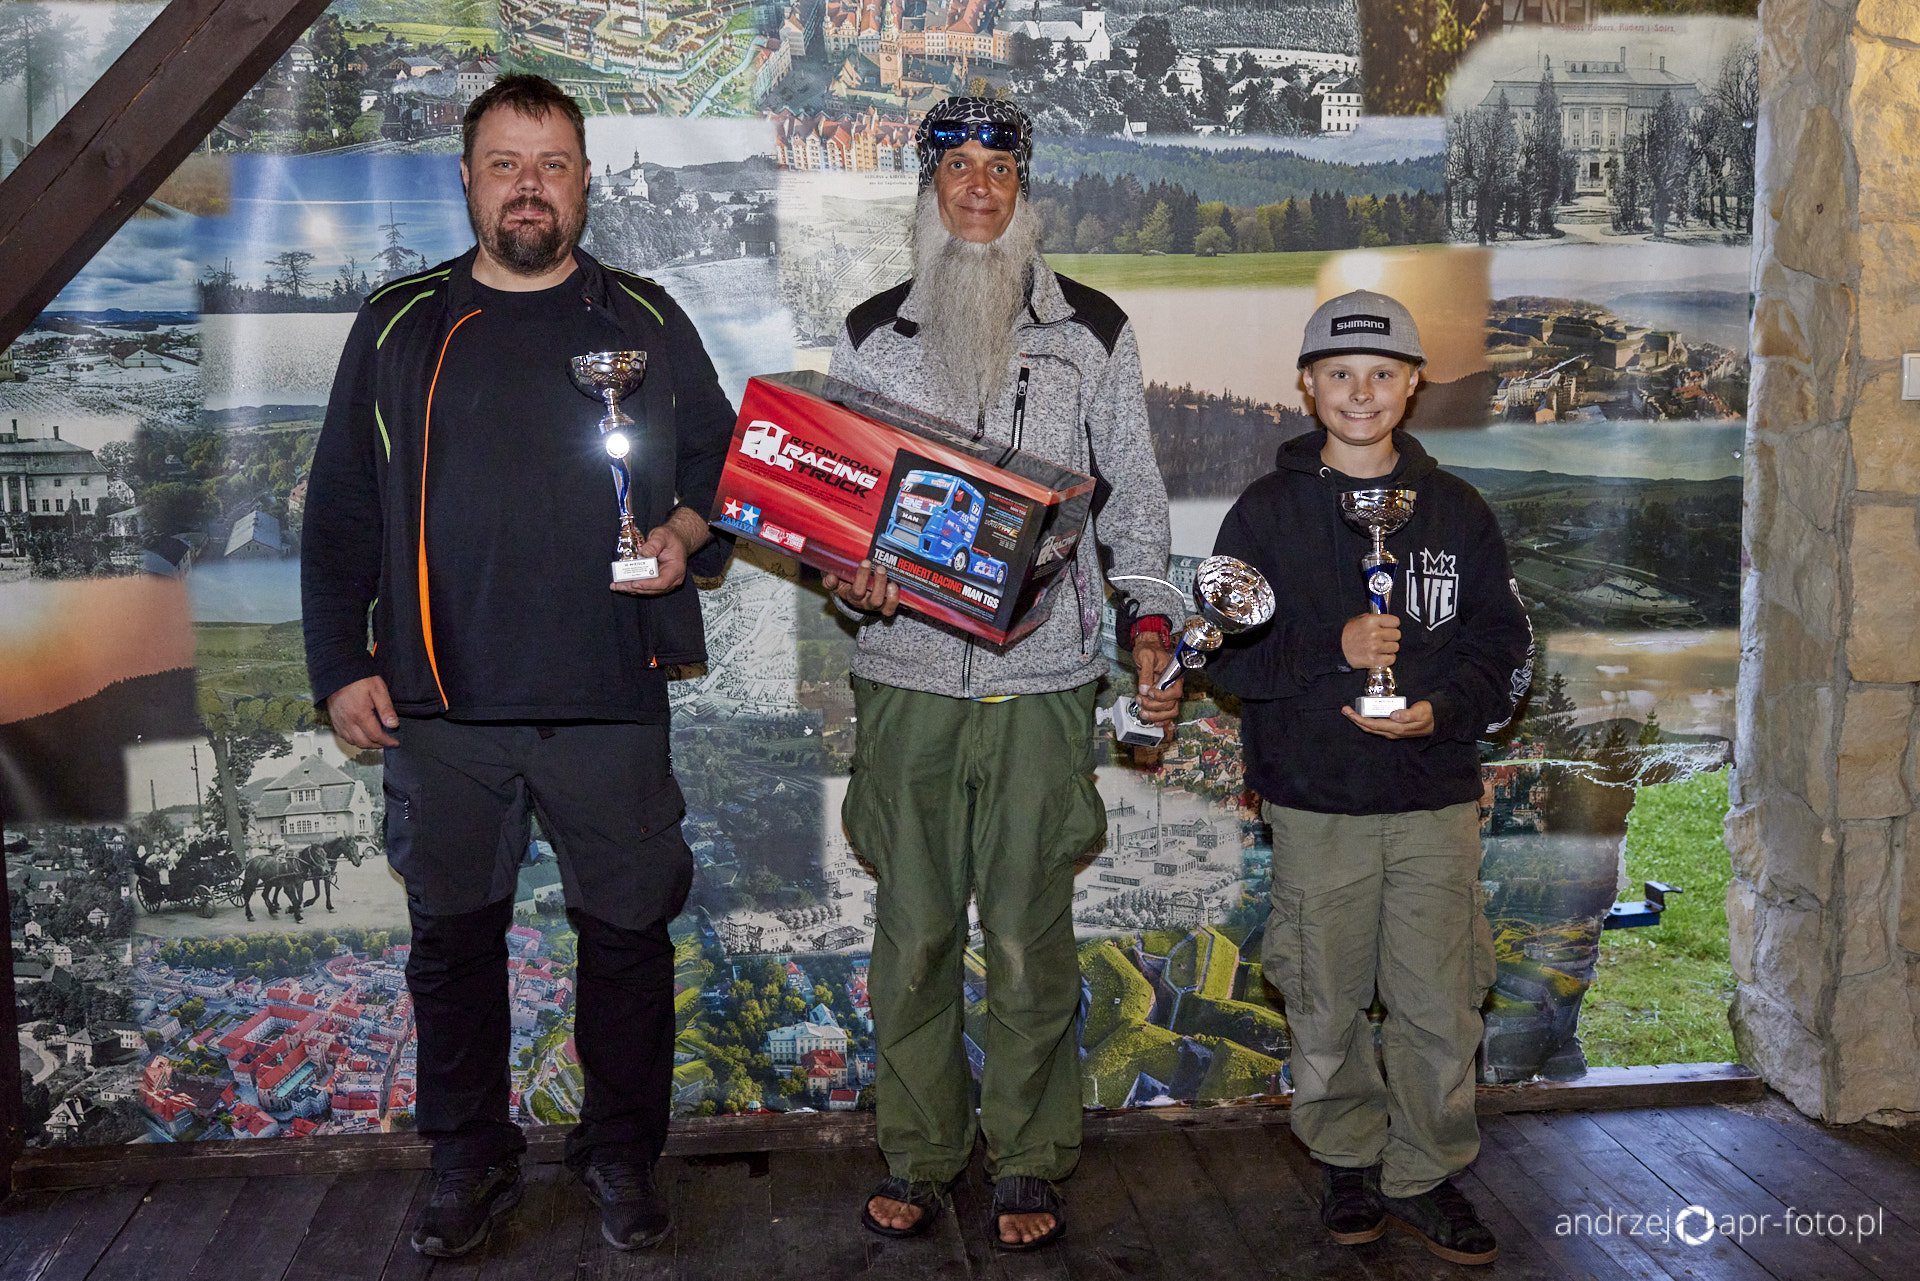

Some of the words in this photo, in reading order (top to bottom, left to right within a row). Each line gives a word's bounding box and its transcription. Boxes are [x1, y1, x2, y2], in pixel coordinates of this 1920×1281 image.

[1336, 319, 1385, 330] SHIMANO
[781, 442, 879, 490] RACING
[814, 446, 838, 459] ON
[838, 455, 882, 478] ROAD
[797, 461, 870, 499] TRUCK
[719, 513, 754, 534] TAMIYA
[902, 511, 919, 523] MAN
[874, 548, 898, 567] TEAM
[897, 557, 933, 580] REINERT
[931, 572, 963, 594] RACING
[961, 584, 984, 602] MAN
[982, 593, 1000, 609] TGS
